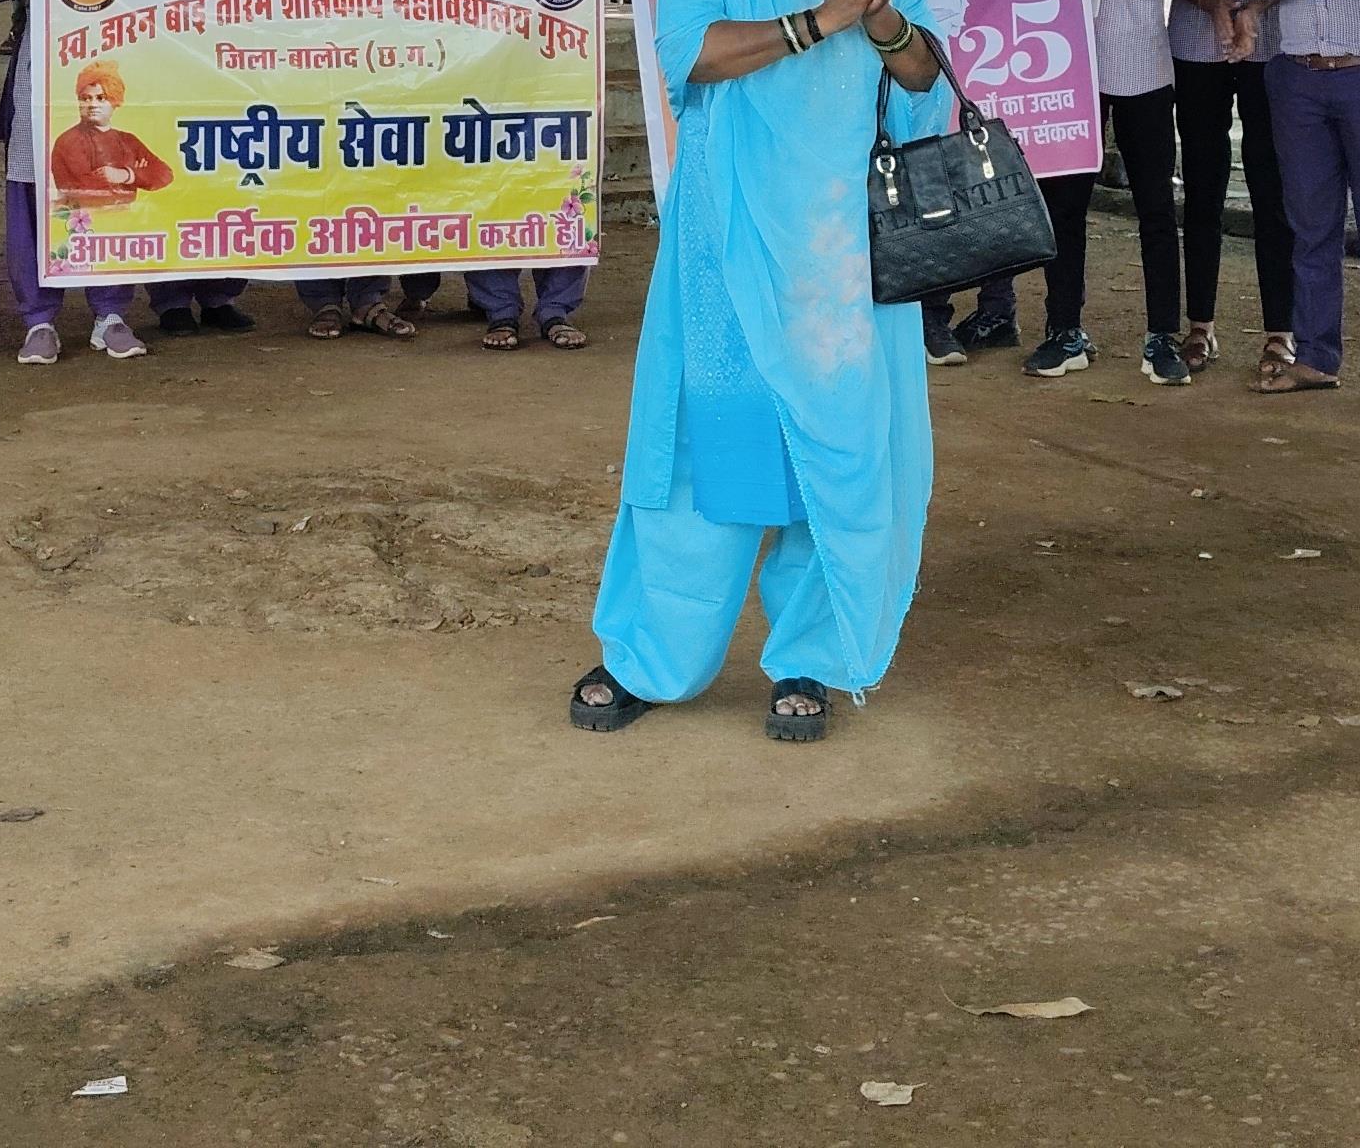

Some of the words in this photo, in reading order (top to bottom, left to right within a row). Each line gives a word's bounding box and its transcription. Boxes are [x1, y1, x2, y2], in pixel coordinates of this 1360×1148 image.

[999, 95, 1025, 116] का
[1026, 89, 1075, 113] उत्सव
[178, 105, 324, 186] राष्ट्रीय
[339, 102, 430, 167] सेवा
[444, 98, 592, 164] योजना
[1031, 119, 1089, 145] संकल्प
[70, 234, 167, 264] आपका
[178, 208, 297, 259] हार्दिक
[308, 205, 472, 254] अभिनंदन
[478, 214, 547, 248] करती
